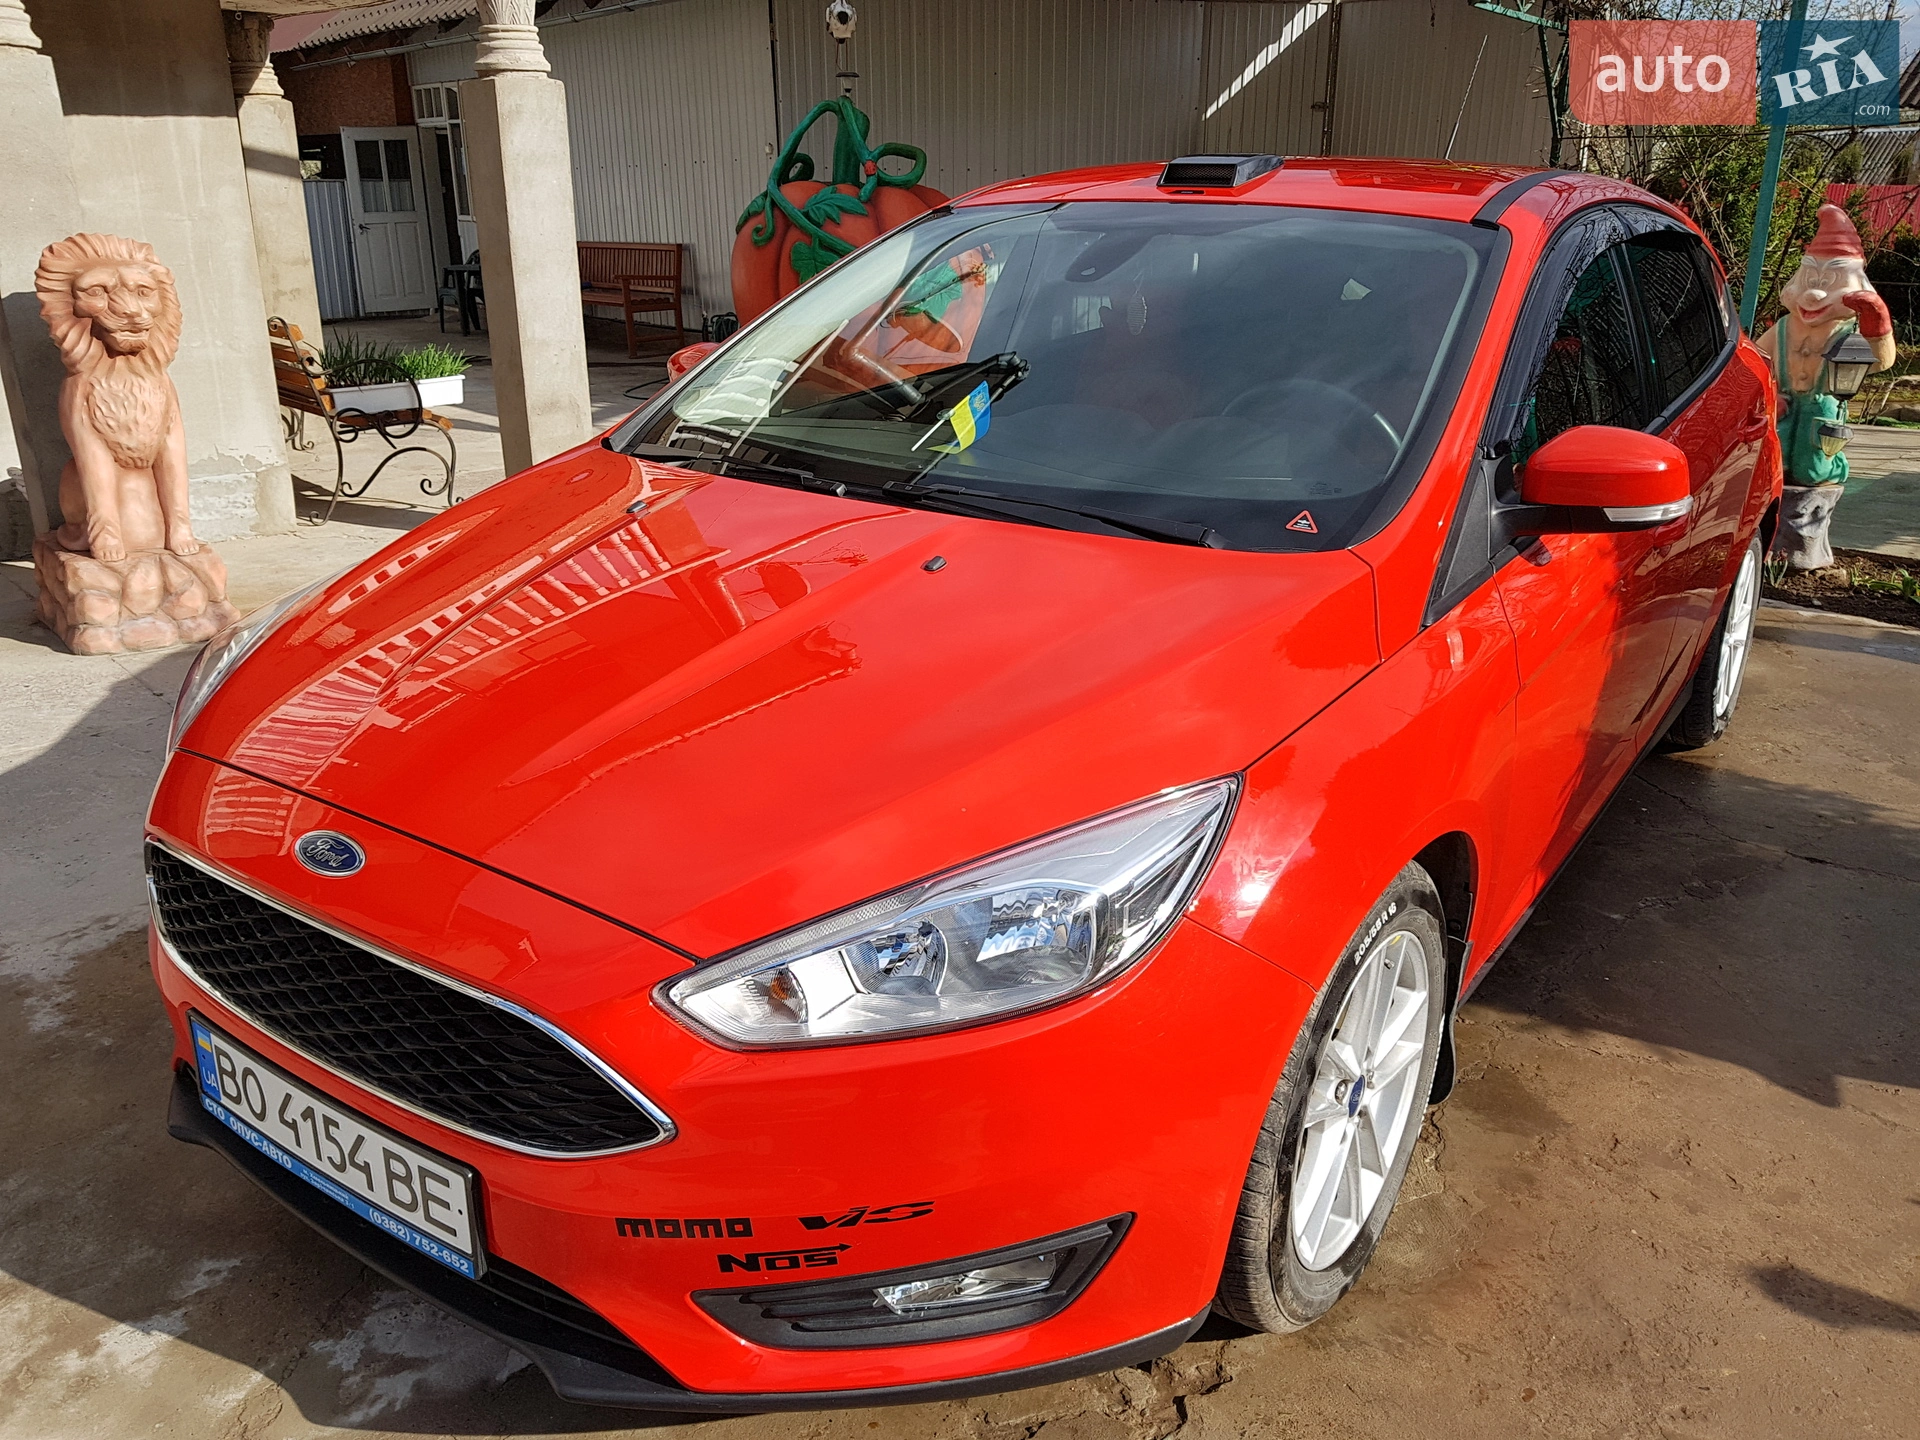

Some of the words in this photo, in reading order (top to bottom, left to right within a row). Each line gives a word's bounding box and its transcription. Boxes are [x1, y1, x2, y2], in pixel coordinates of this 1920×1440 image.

[306, 838, 349, 867] Ford
[202, 1066, 219, 1091] UA
[205, 1098, 225, 1120] СТО
[230, 1116, 292, 1169] ОПУС-АВТО
[369, 1207, 410, 1242] (0382)
[412, 1233, 470, 1273] 752-652
[214, 1044, 267, 1123] BO
[278, 1092, 375, 1193] 4154
[381, 1146, 458, 1238] BE
